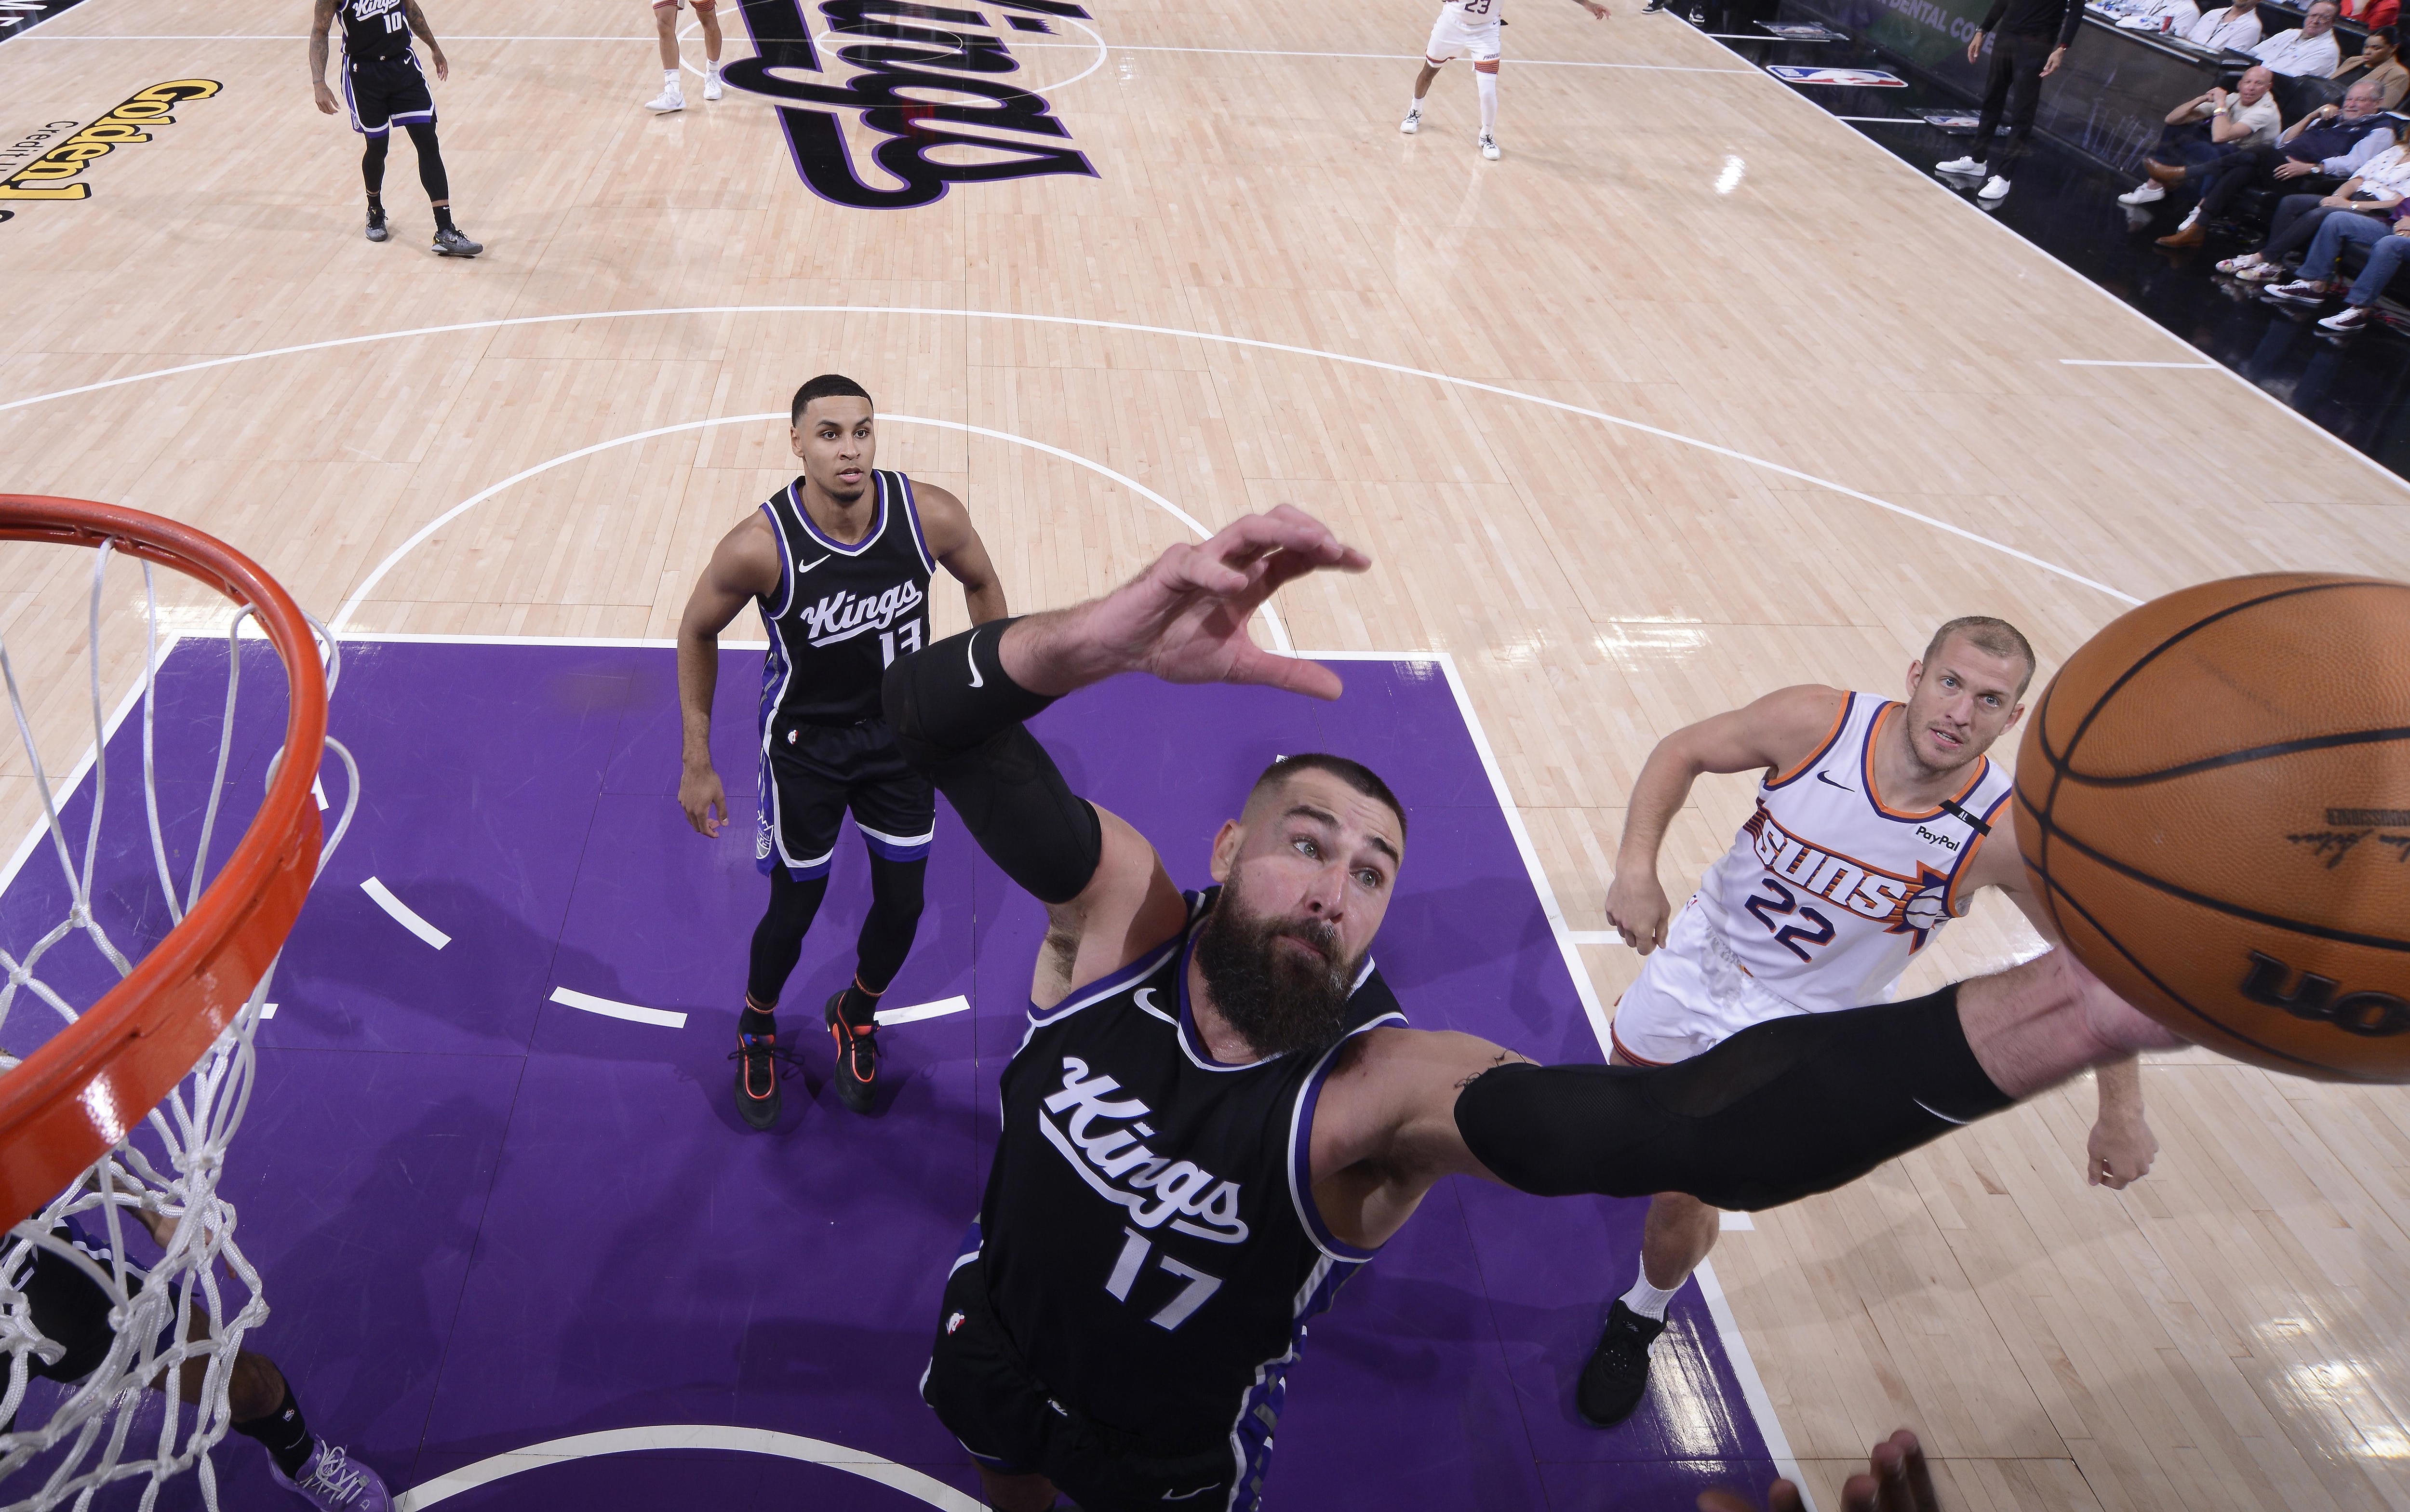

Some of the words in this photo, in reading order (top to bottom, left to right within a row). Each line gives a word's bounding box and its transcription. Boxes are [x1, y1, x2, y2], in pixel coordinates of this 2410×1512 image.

[384, 12, 402, 33] 10
[1464, 0, 1491, 14] 23
[1889, 0, 1948, 32] DENTAL
[1950, 17, 1996, 54] COE
[11, 79, 223, 181] Golden
[720, 0, 1102, 209] ings
[0, 121, 79, 157] Credit
[800, 579, 923, 648] Kings
[879, 617, 921, 671] 13
[1915, 826, 1960, 852] PayPal
[1958, 811, 1968, 821] AL
[1744, 878, 1836, 963] 22
[1039, 1057, 1249, 1244] Kings
[1105, 1226, 1226, 1331] 17
